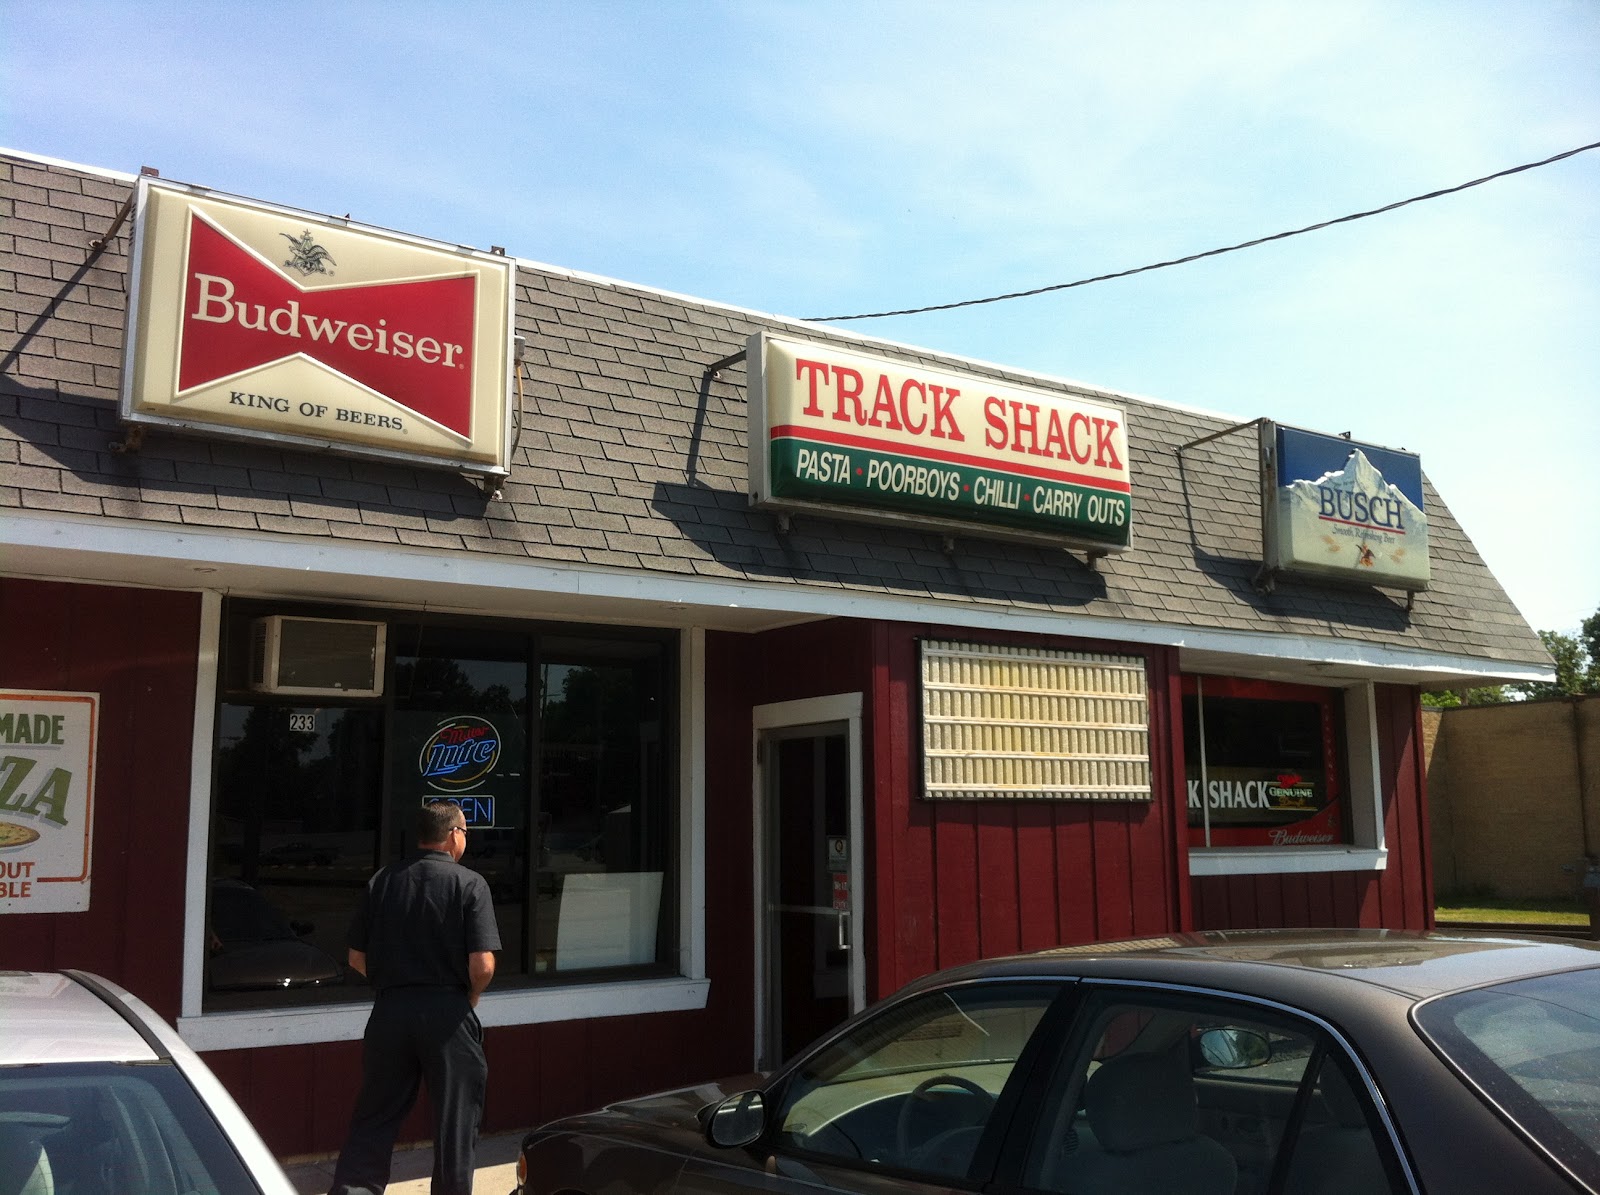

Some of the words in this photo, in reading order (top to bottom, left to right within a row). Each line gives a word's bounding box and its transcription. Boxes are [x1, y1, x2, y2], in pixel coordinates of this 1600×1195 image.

[191, 272, 464, 369] Budweiser
[229, 391, 290, 413] KING
[299, 402, 328, 418] OF
[335, 409, 403, 431] BEERS
[796, 358, 965, 442] TRACK
[984, 396, 1124, 471] SHACK
[796, 449, 851, 485] PASTA
[866, 459, 961, 501] POORBOYS
[973, 476, 1021, 510] CHILLI
[1033, 486, 1084, 520] CARRY
[1087, 496, 1125, 526] OUTS
[1318, 486, 1405, 530] BUSCH
[290, 715, 314, 731] 233
[422, 738, 497, 776] Lite
[428, 798, 492, 822] EN
[1208, 780, 1271, 809] SHACK
[1268, 786, 1313, 798] GENUINE
[1268, 829, 1334, 846] Budweiser
